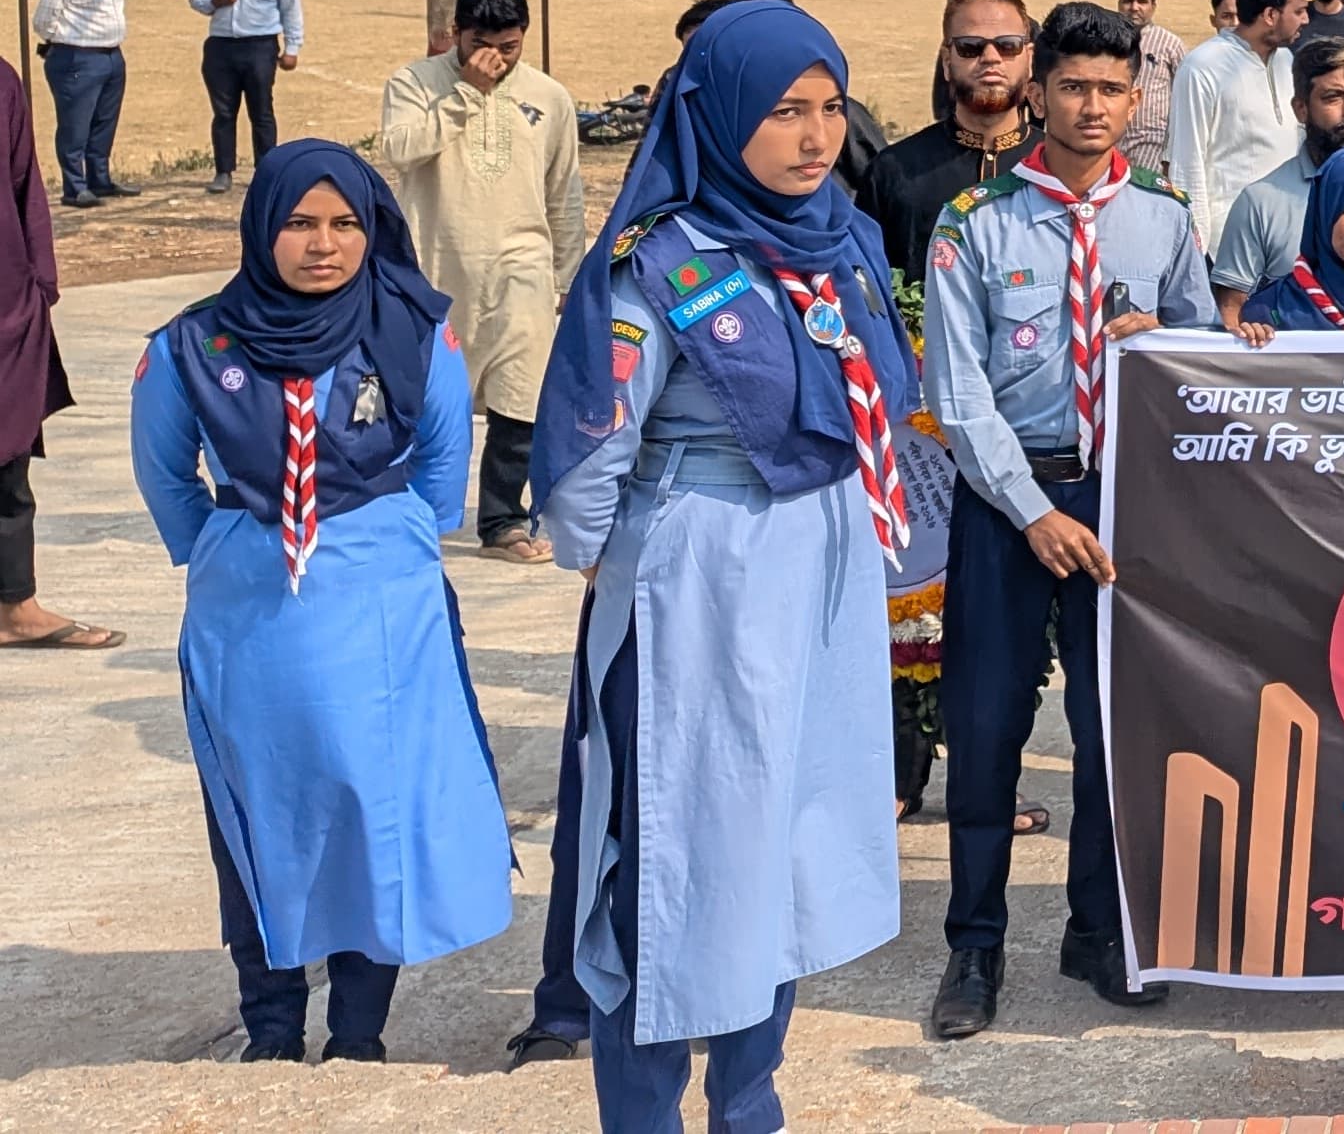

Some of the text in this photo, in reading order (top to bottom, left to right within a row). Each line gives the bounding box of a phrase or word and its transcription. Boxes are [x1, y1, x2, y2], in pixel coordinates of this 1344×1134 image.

[683, 290, 724, 319] SABIHA
[1172, 422, 1258, 461] আমি
[1264, 422, 1312, 462] কি
